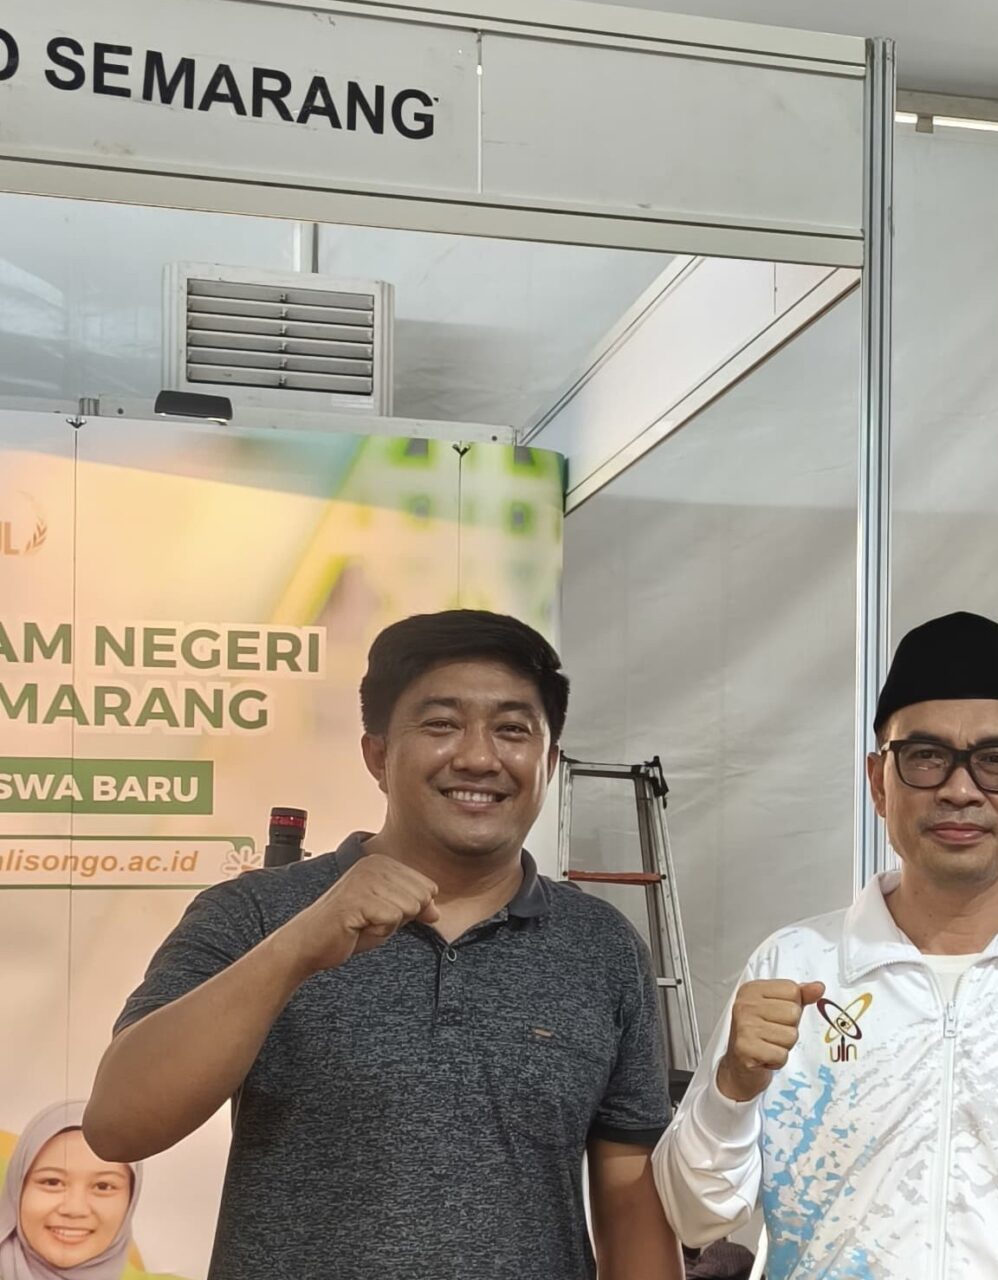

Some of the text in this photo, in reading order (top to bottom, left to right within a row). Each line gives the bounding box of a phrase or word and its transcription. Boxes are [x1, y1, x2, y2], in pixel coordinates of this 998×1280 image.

[44, 36, 435, 140] SEMARANG
[94, 625, 320, 673] NEGERI
[92, 775, 199, 802] BARU
[0, 850, 198, 878] lisongo.ac.id
